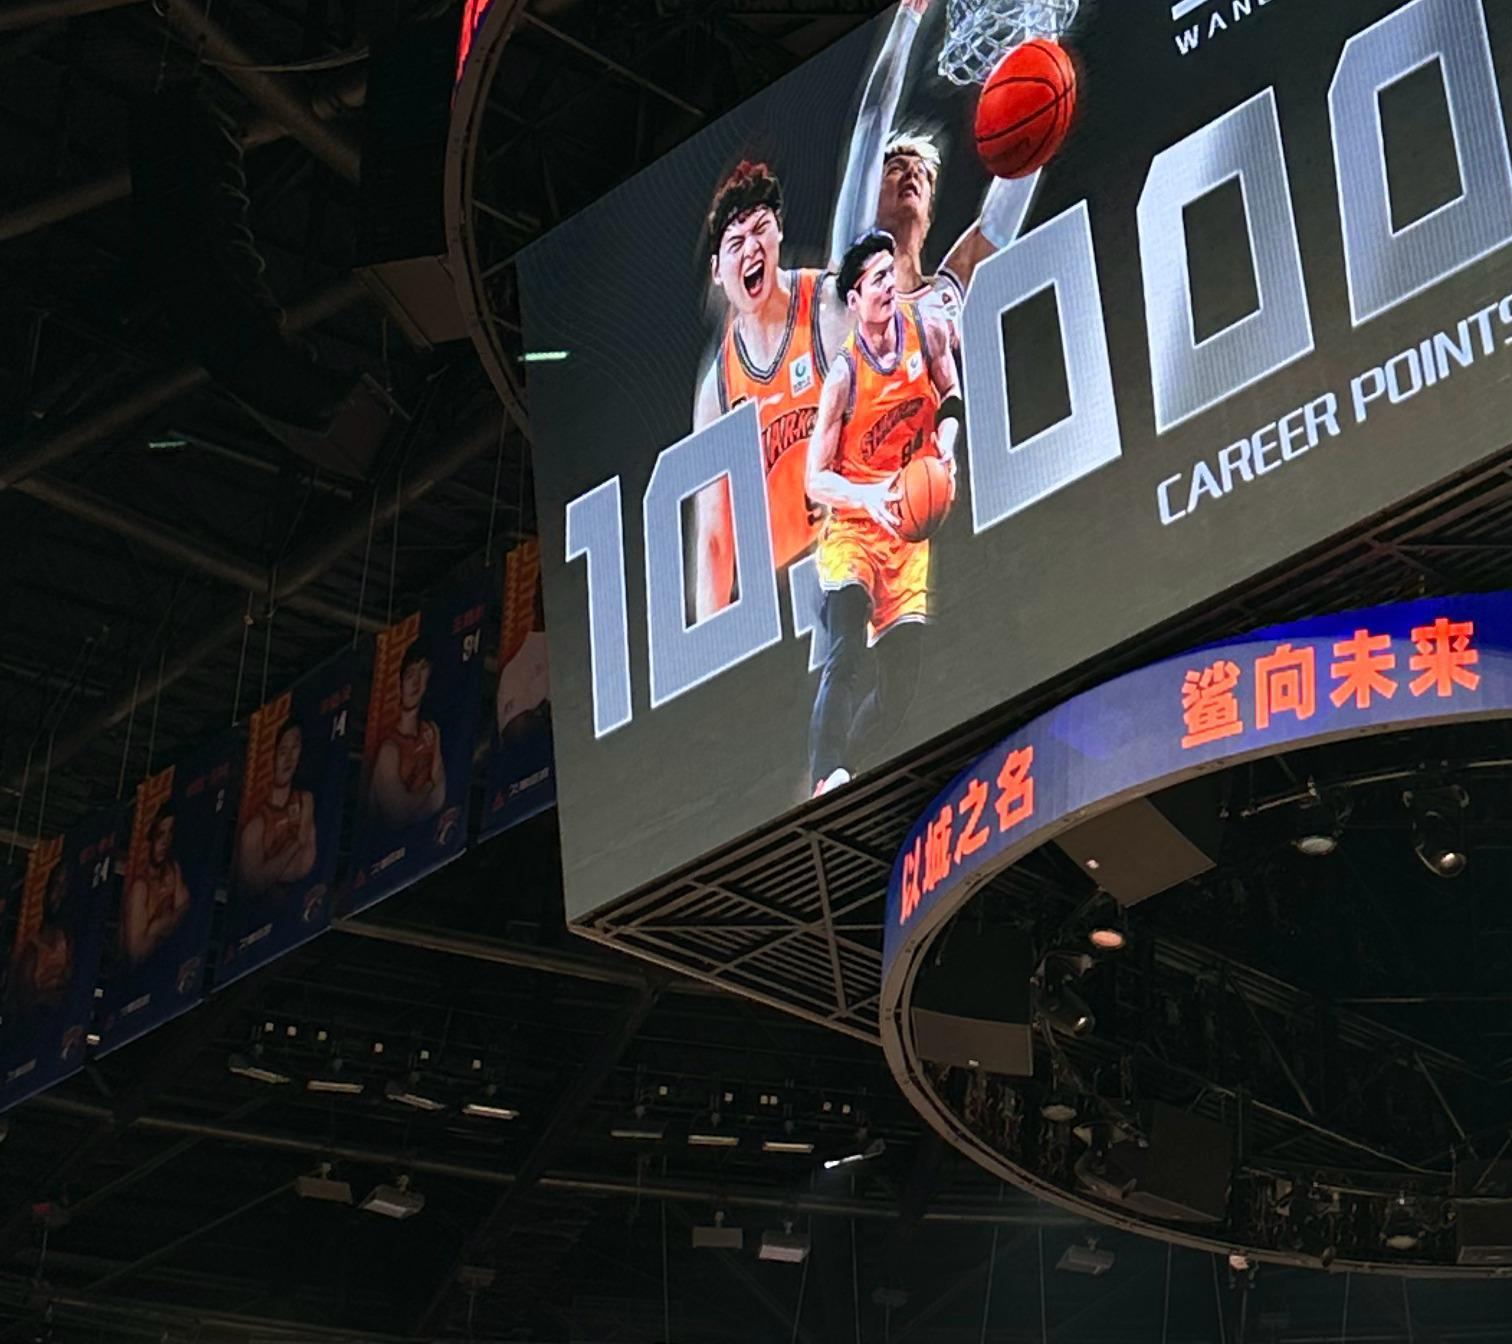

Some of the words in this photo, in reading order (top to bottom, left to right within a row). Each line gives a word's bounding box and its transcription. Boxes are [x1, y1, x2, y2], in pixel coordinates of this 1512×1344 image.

[1157, 392, 1340, 525] CAREER
[1180, 616, 1481, 751] 鲨向未来
[900, 745, 1034, 926] 以城之名
